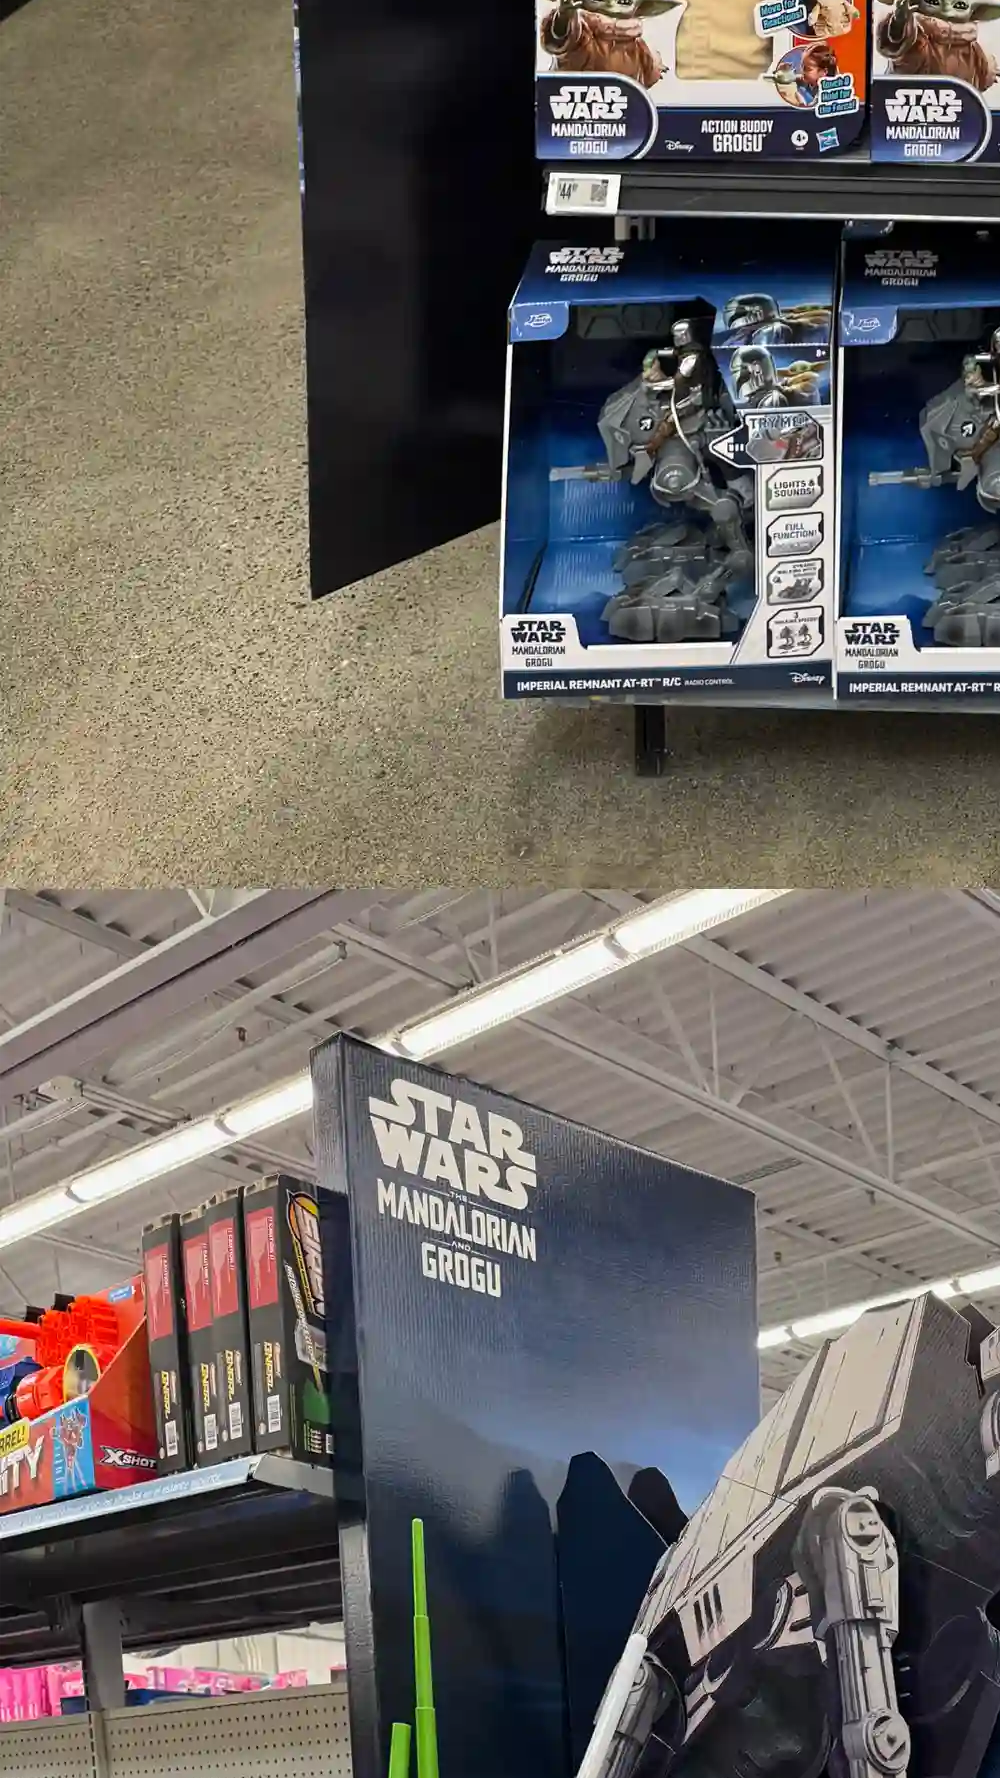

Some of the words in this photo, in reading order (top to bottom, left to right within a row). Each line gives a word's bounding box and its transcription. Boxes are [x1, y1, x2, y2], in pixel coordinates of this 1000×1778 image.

[773, 480, 806, 490] LIGHTS
[774, 488, 815, 498] SOUNDS!
[785, 523, 805, 532] FULL
[773, 529, 817, 540] FUNCTION!
[511, 620, 566, 633] STAR
[512, 631, 566, 643] WARS
[512, 645, 566, 656] MANDALORIAN
[525, 657, 553, 667] GROGU
[517, 680, 567, 691] IMPERIAL
[569, 679, 621, 690] REMNANT
[663, 676, 681, 687] R/C
[790, 672, 825, 685] Disney
[369, 1079, 536, 1171] STAR
[370, 1116, 536, 1209] WARS
[450, 1191, 468, 1203] THE
[377, 1178, 536, 1261] MANDALORIAN
[451, 1241, 471, 1251] AND
[422, 1242, 501, 1297] GROGU
